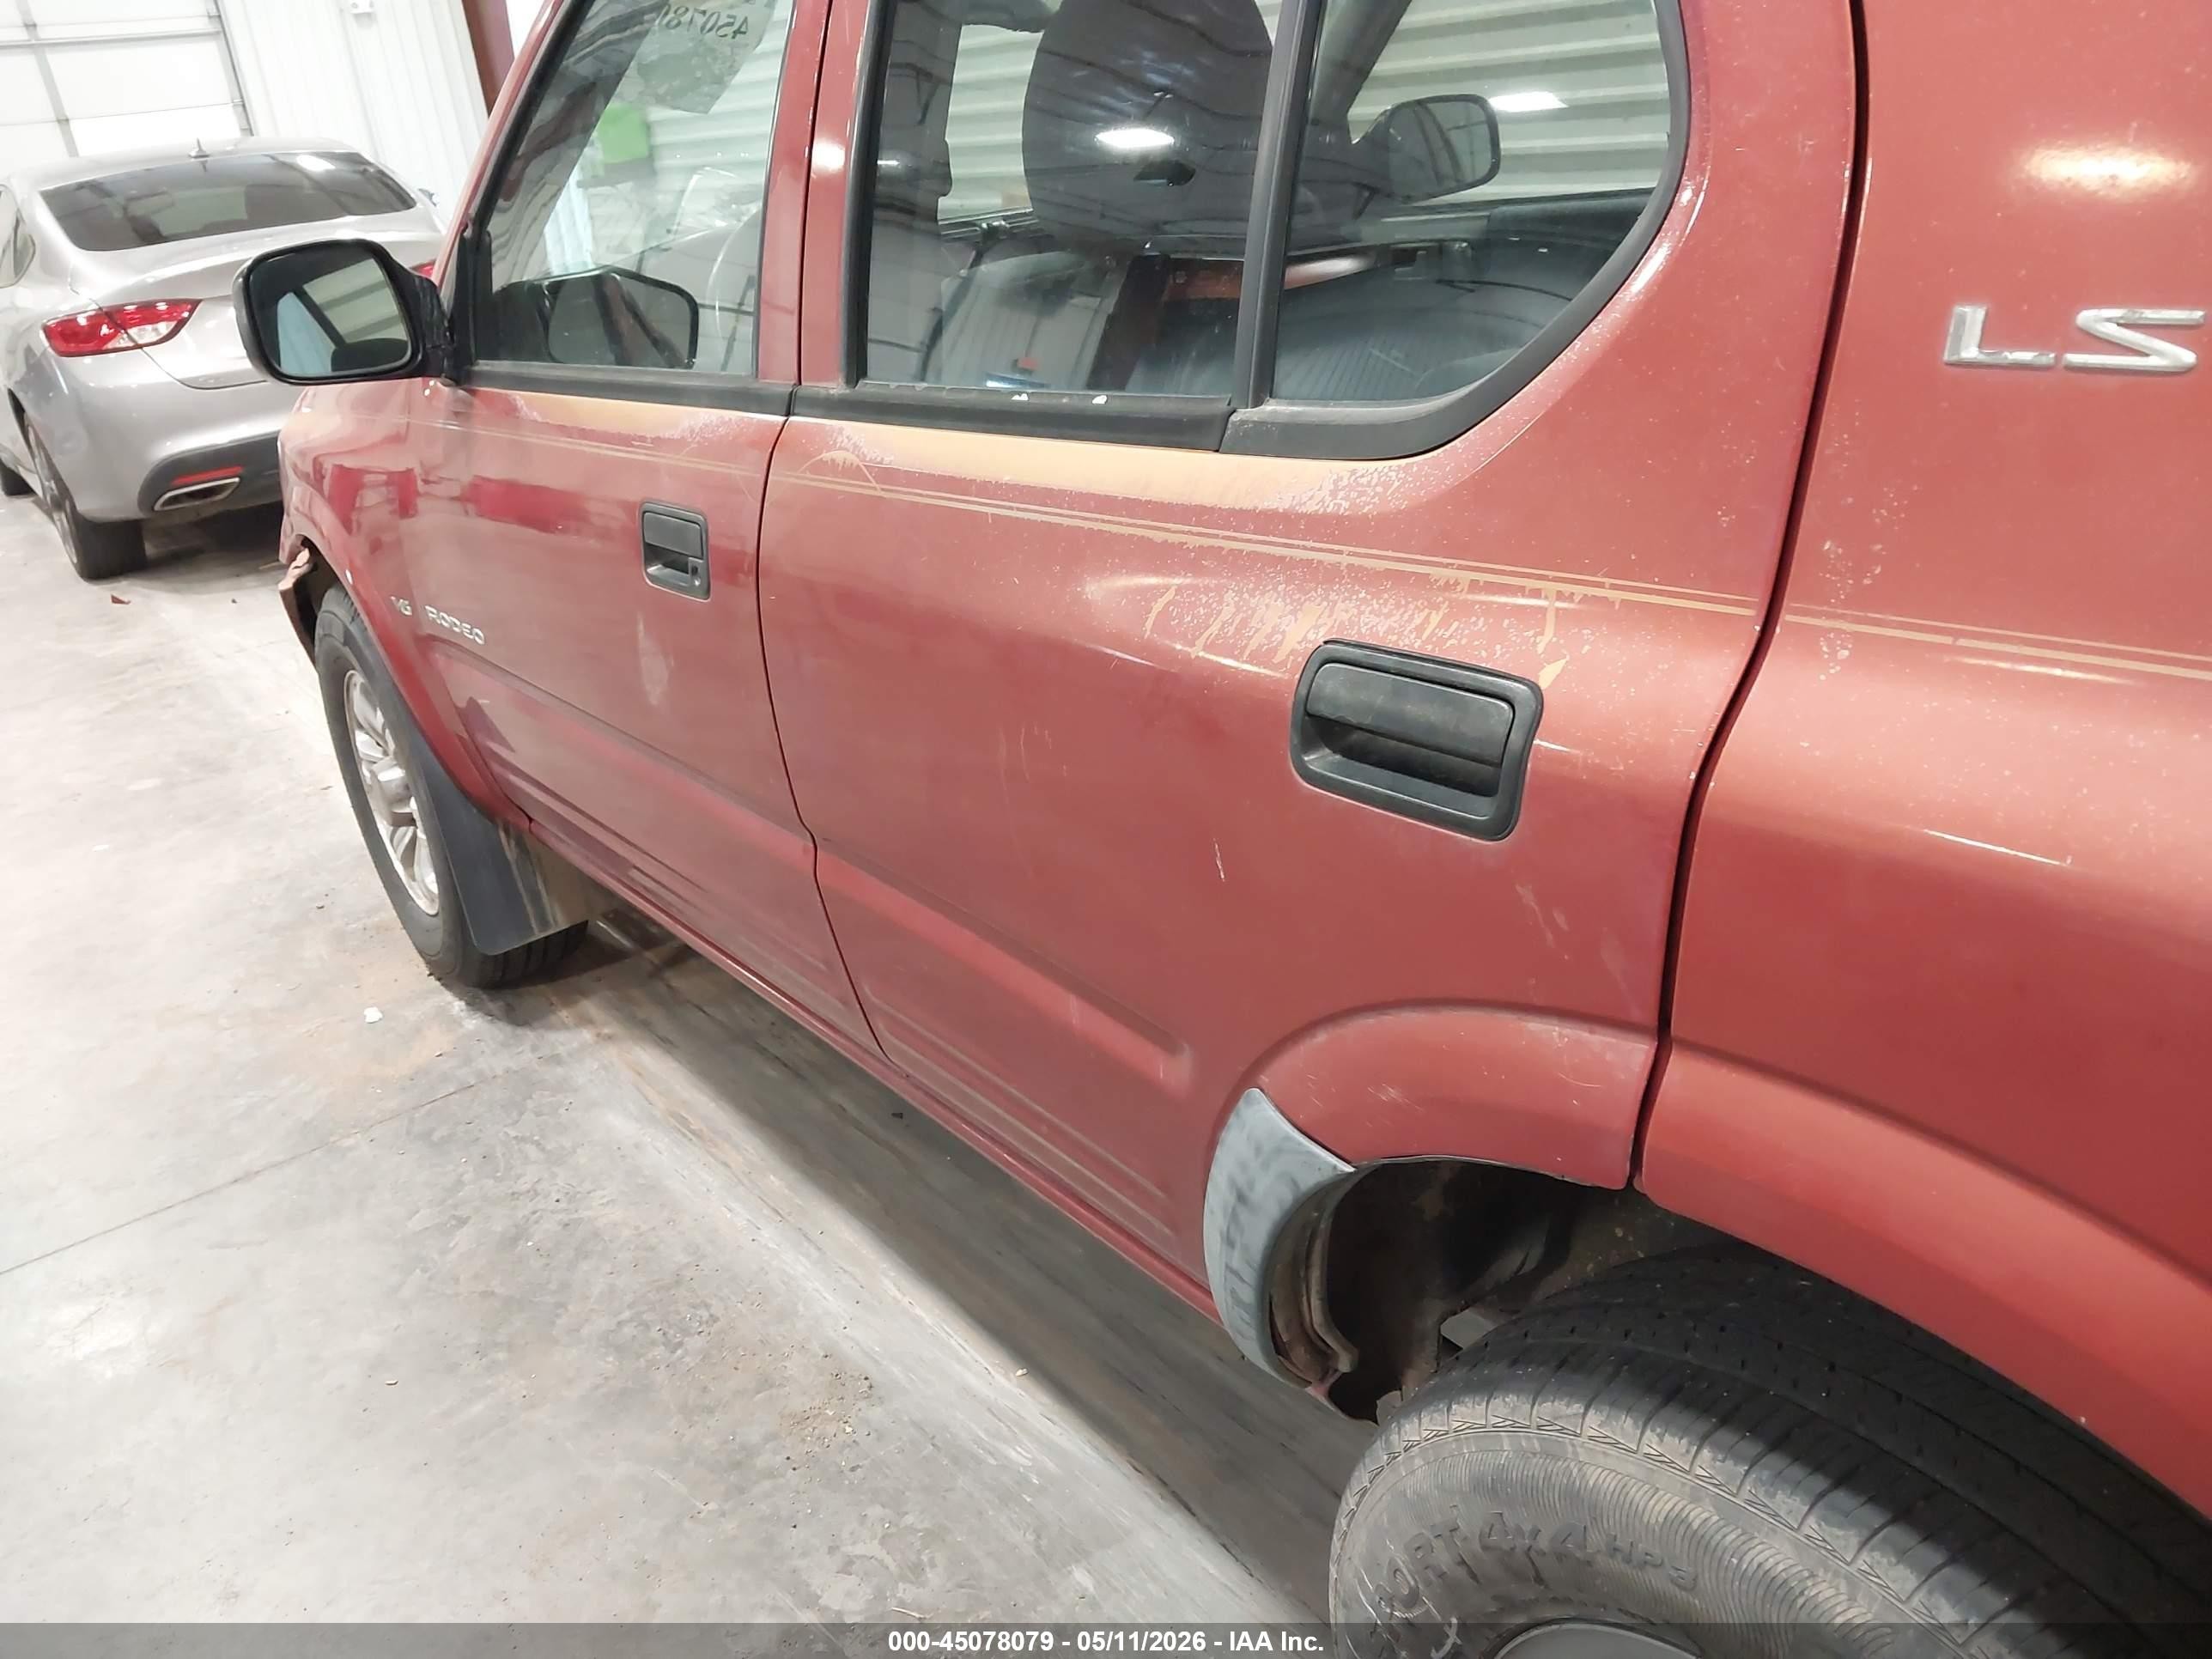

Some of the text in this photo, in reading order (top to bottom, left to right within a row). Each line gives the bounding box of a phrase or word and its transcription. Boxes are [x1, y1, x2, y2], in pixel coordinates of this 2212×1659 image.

[1943, 305, 2206, 373] LS
[389, 594, 486, 646] V6 RODEO
